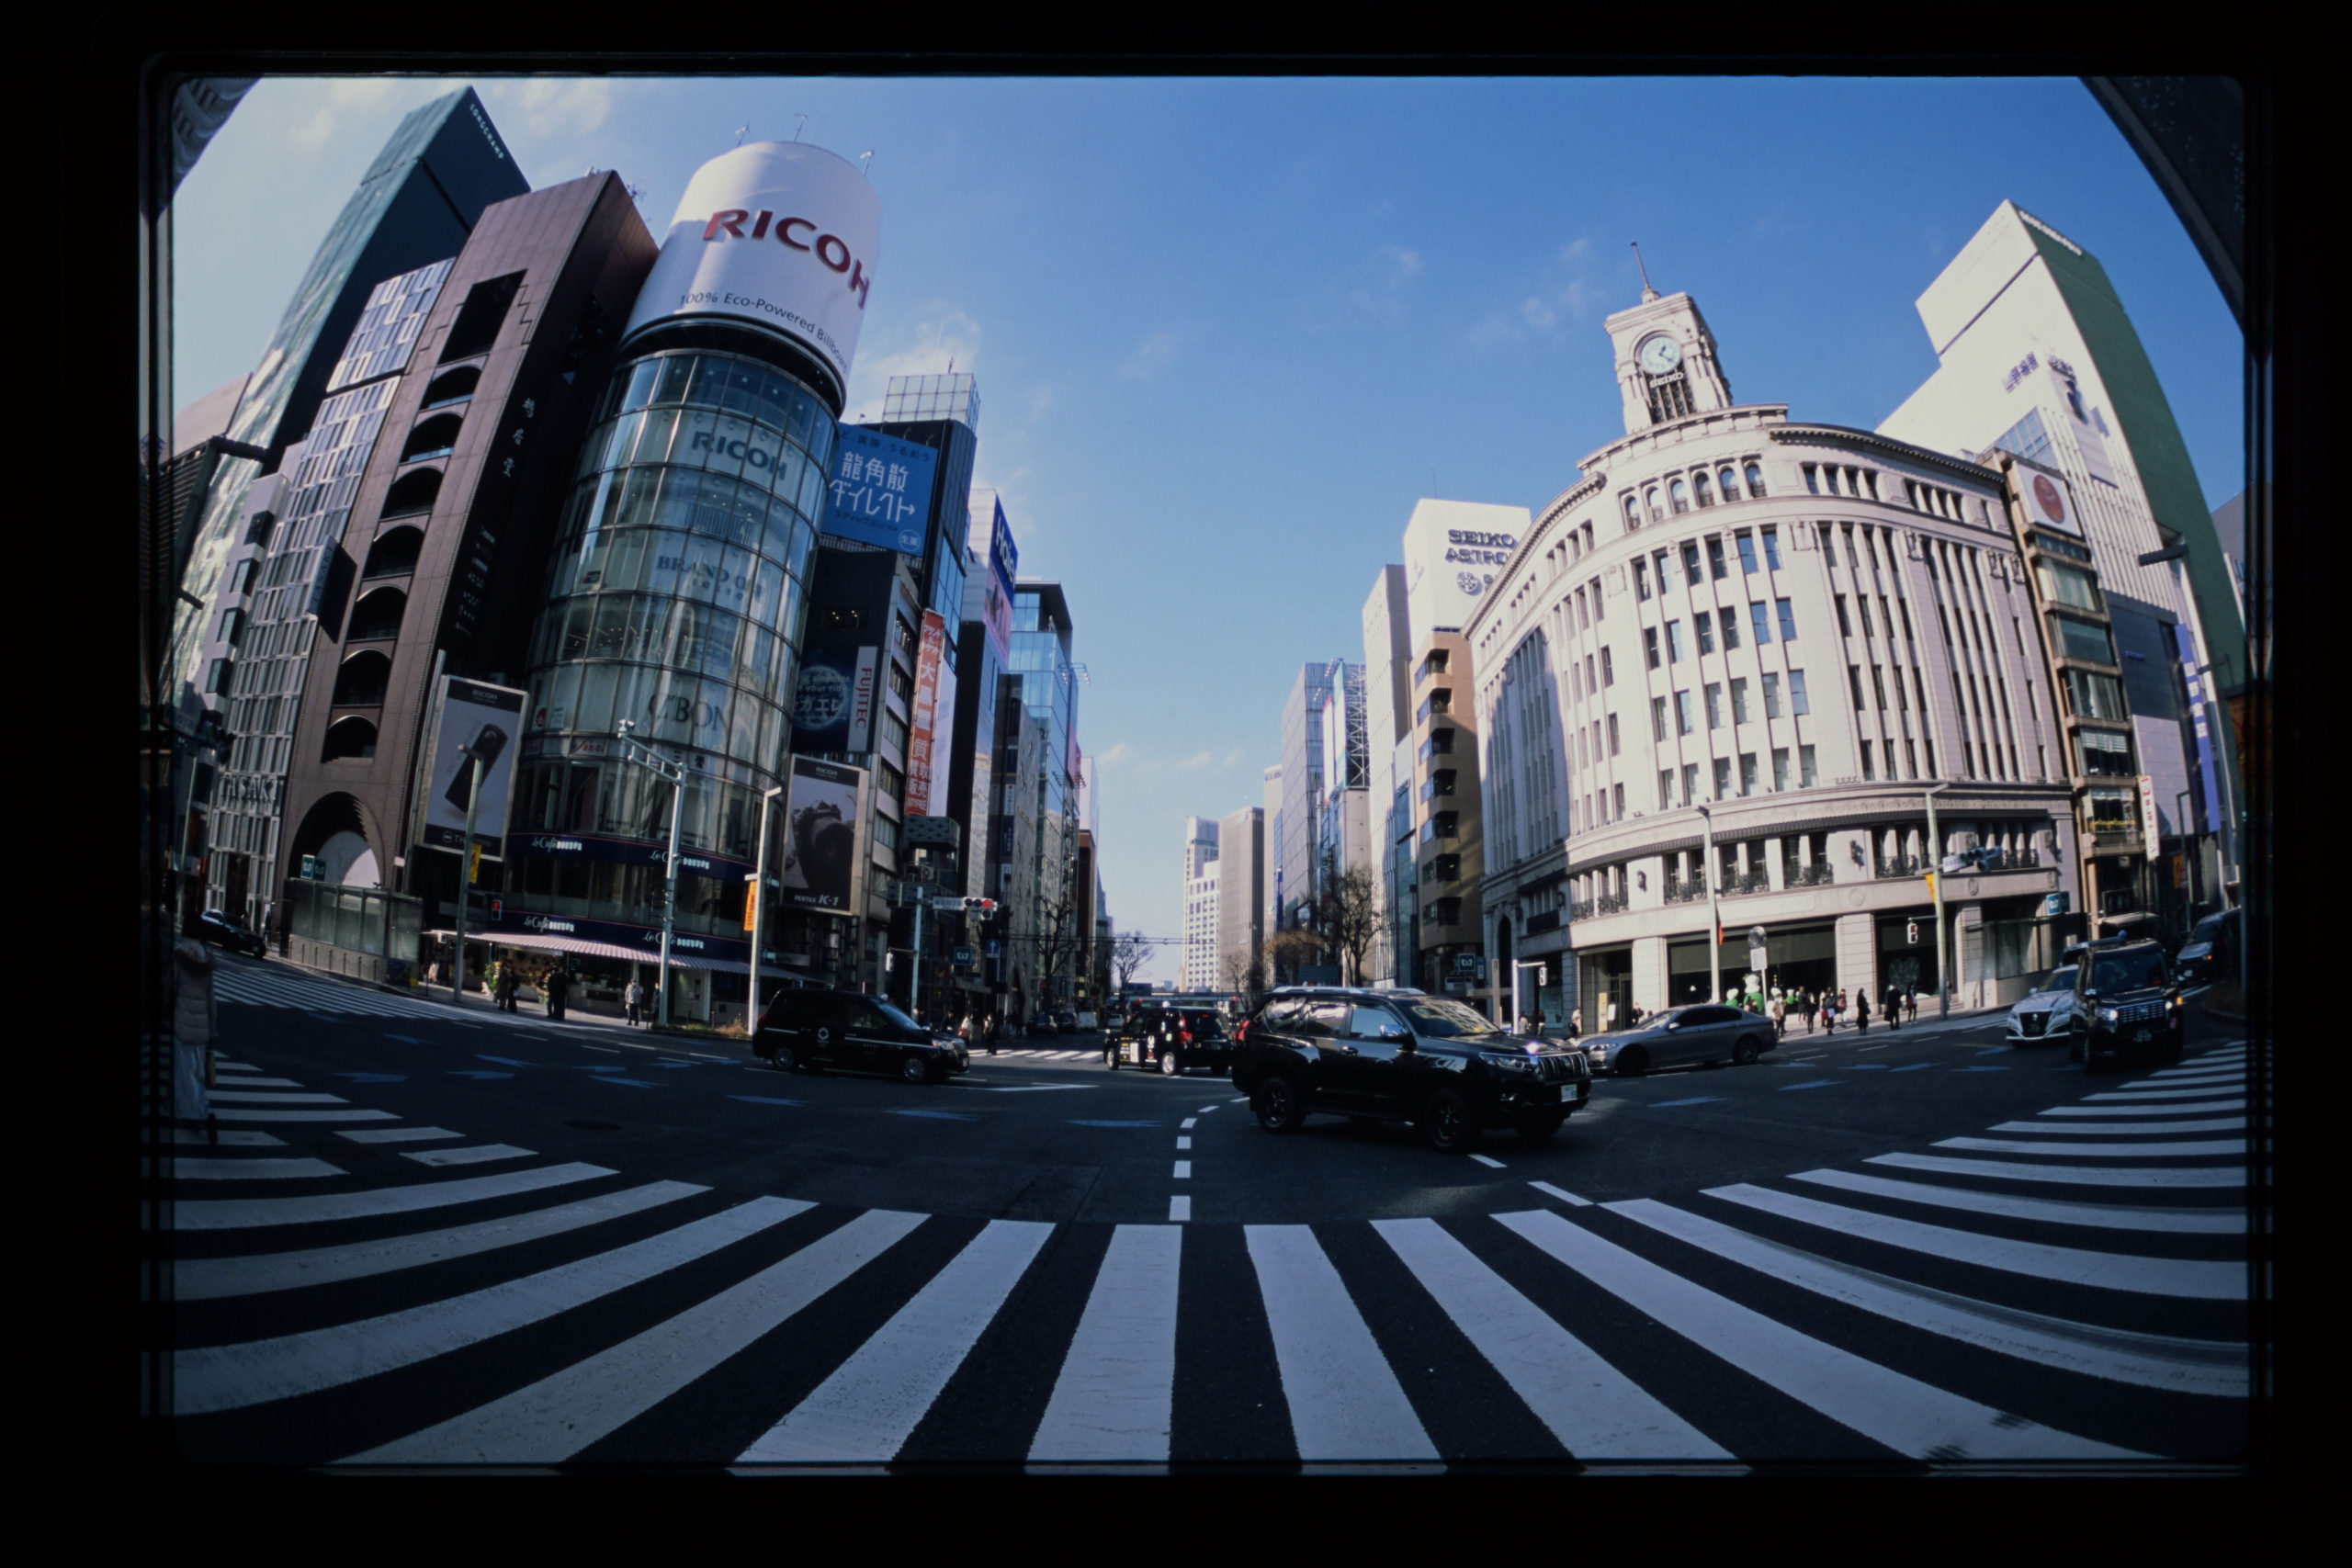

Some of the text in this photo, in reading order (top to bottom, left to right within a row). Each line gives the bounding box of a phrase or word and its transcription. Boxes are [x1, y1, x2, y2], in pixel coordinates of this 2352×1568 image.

[702, 209, 871, 310] RICOH
[680, 292, 718, 305] 100%
[723, 292, 816, 334] Eco-Powered
[1649, 371, 1684, 389] SEIKO
[692, 431, 787, 480] RICOH
[840, 449, 910, 494] 龍角散
[829, 478, 916, 524] ダイレクト
[1445, 547, 1512, 566] ASTRO
[1447, 528, 1516, 549] SEIKO
[855, 667, 873, 729] FUJITEC
[818, 894, 840, 907] K-1
